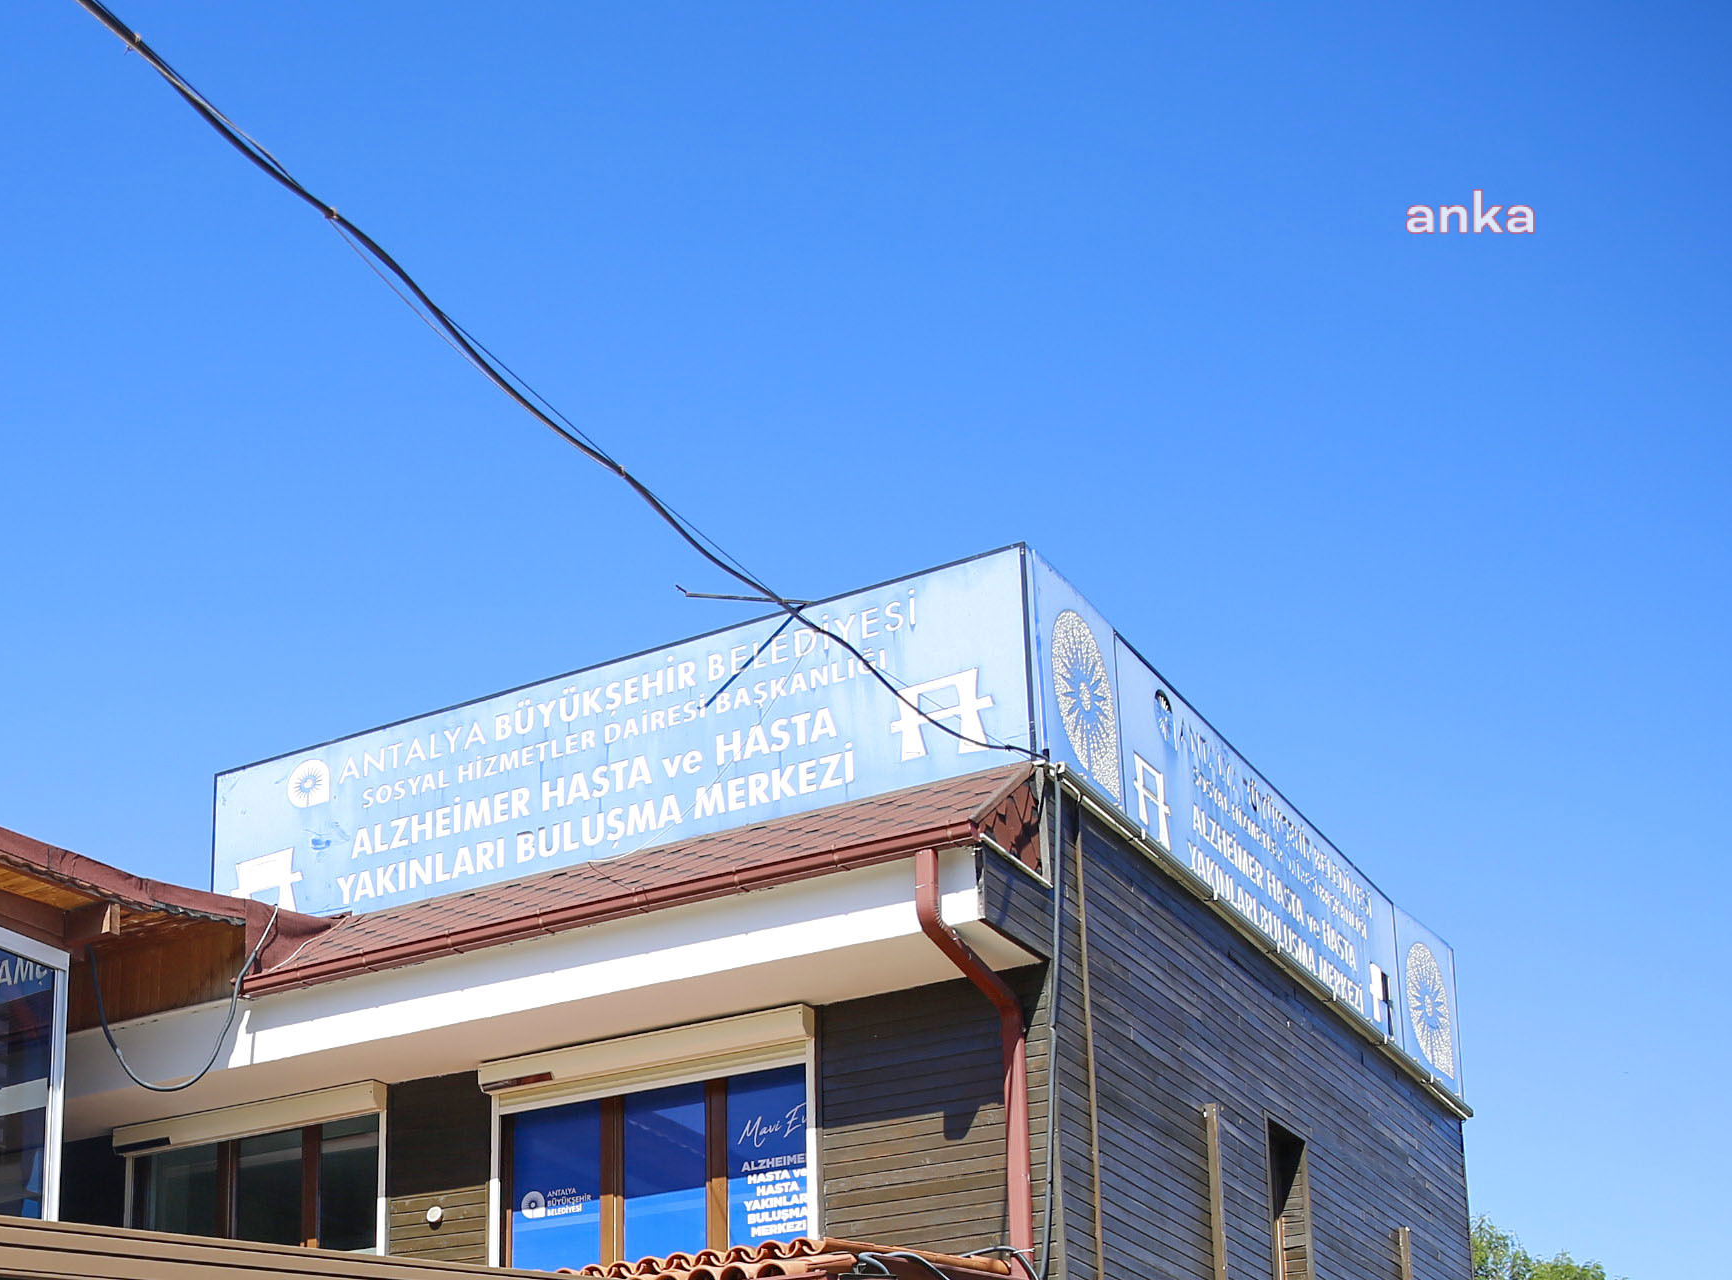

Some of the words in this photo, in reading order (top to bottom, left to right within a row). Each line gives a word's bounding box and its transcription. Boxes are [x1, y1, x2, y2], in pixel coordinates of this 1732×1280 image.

[339, 722, 486, 784] ANTALYA
[495, 656, 696, 741] BÜYÜKŞEHİR
[708, 589, 916, 681] BELEDİYESİ
[363, 770, 449, 808] SOSYAL
[458, 729, 595, 784] HİZMETLER
[604, 693, 707, 744] DAİRESİ
[715, 648, 886, 710] BAŞKANLIĞI
[351, 787, 530, 859] ALZHEİMER
[541, 755, 652, 811] HASTA
[662, 750, 704, 778] ve
[716, 707, 837, 766] HASTA
[336, 837, 505, 904] YAKINLARI
[516, 794, 683, 864] BULUŞMA
[693, 742, 855, 819] MERKEZİ
[1267, 869, 1305, 926] HASTA
[1307, 912, 1320, 939] ve
[1322, 919, 1357, 972] HASTA
[738, 1115, 782, 1148] Mavi
[547, 1187, 577, 1198] ANTALYA
[748, 1169, 790, 1184] HASTA
[756, 1181, 800, 1196] HASTA
[547, 1193, 592, 1207] BÜYÜKŞEHİR
[547, 1203, 582, 1216] BELEDİYESİ
